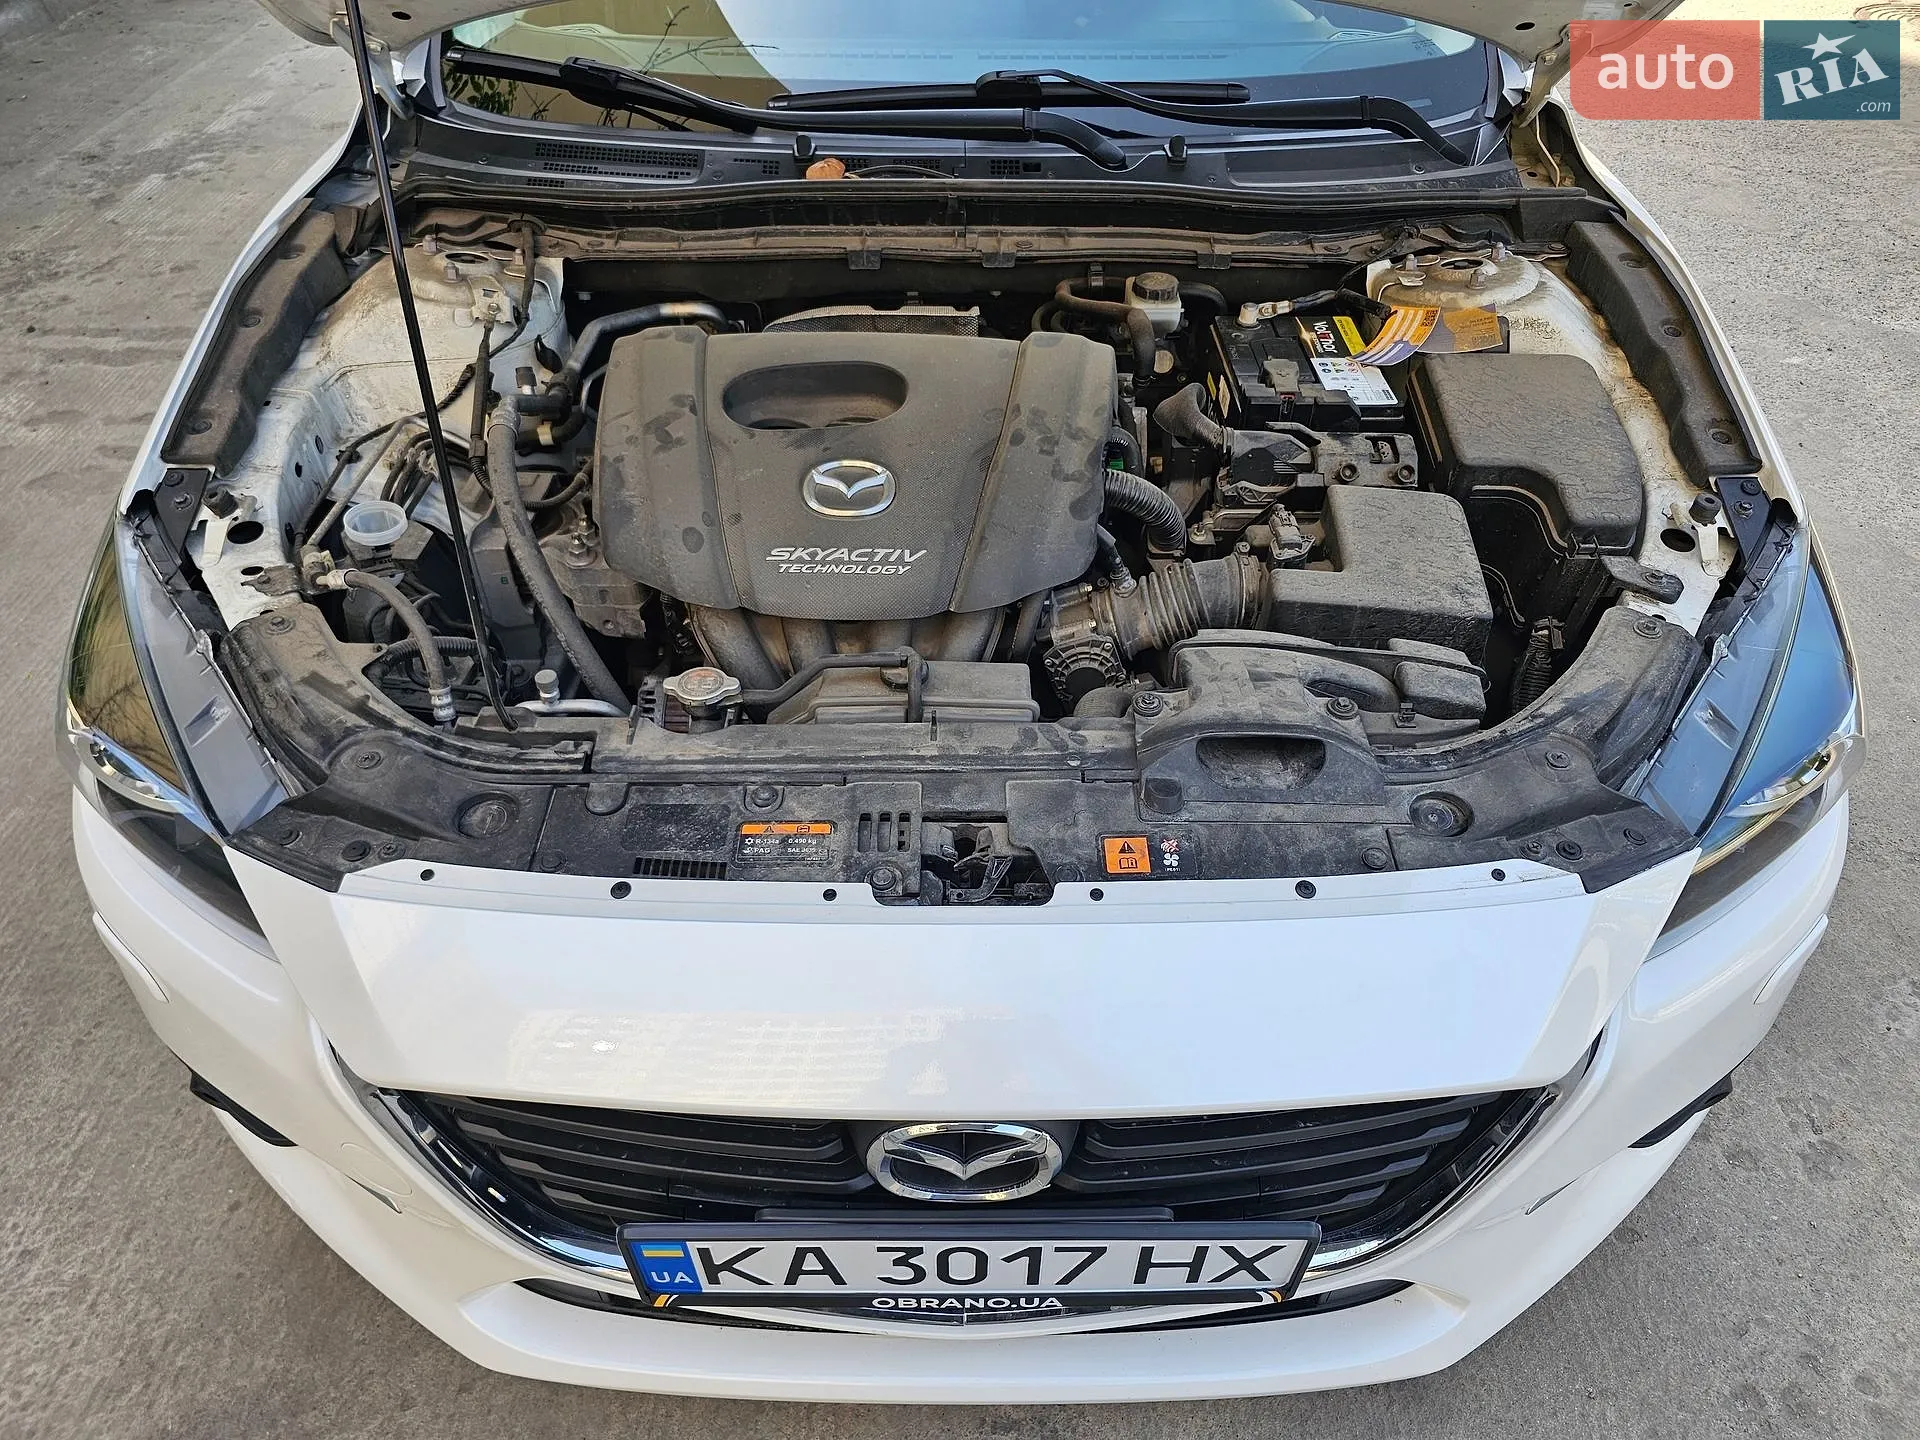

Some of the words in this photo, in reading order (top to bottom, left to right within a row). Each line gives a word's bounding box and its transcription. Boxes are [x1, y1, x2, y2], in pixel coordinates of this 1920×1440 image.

[766, 547, 928, 563] SKYACTIV
[779, 564, 912, 575] TECHNOLOGY
[697, 1246, 848, 1286] KA
[876, 1246, 1107, 1286] 3017
[1133, 1245, 1287, 1285] HX
[652, 1271, 694, 1284] UA
[872, 1297, 1063, 1309] OBRANO.UA
